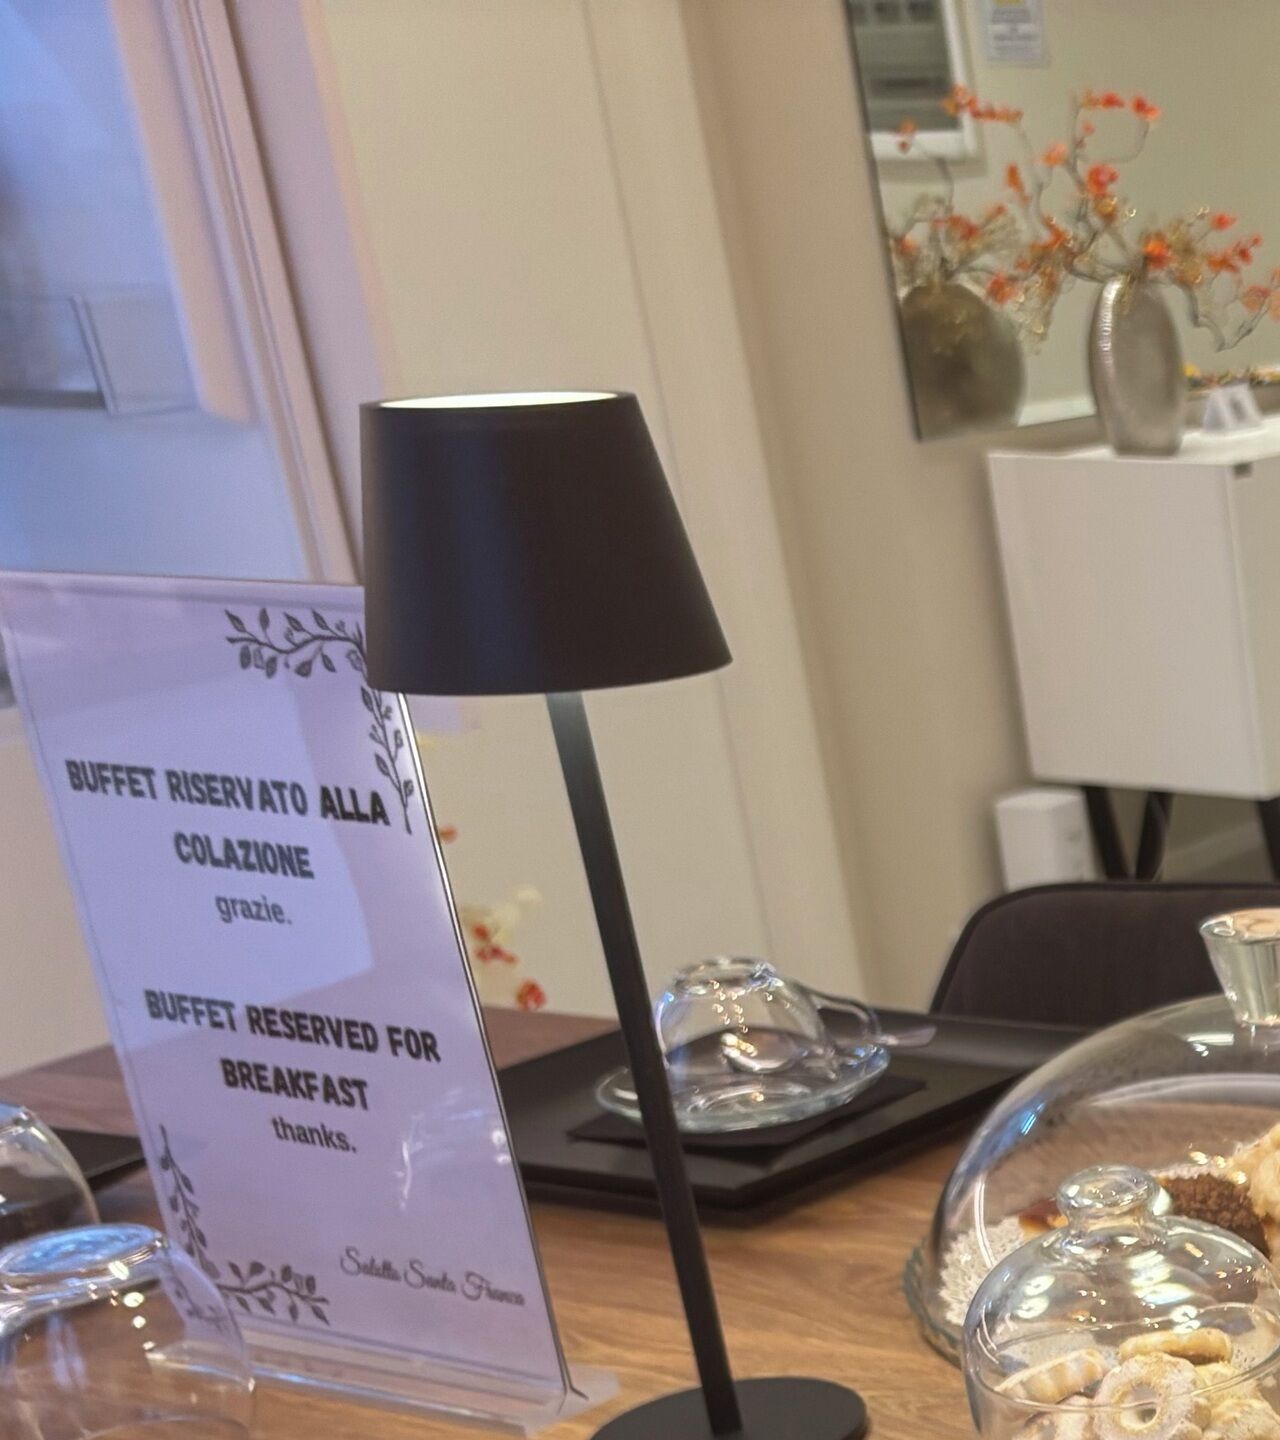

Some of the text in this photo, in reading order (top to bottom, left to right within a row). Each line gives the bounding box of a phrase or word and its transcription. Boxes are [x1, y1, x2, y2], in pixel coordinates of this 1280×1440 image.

[65, 759, 391, 826] BUFFET RISERVATO ALLA
[173, 831, 315, 879] COLAZIONE
[215, 895, 292, 925] grazie.
[144, 988, 441, 1063] BUFFET RESERVED FOR
[219, 1057, 368, 1110] BREAKFAST
[271, 1116, 357, 1153] thanks.
